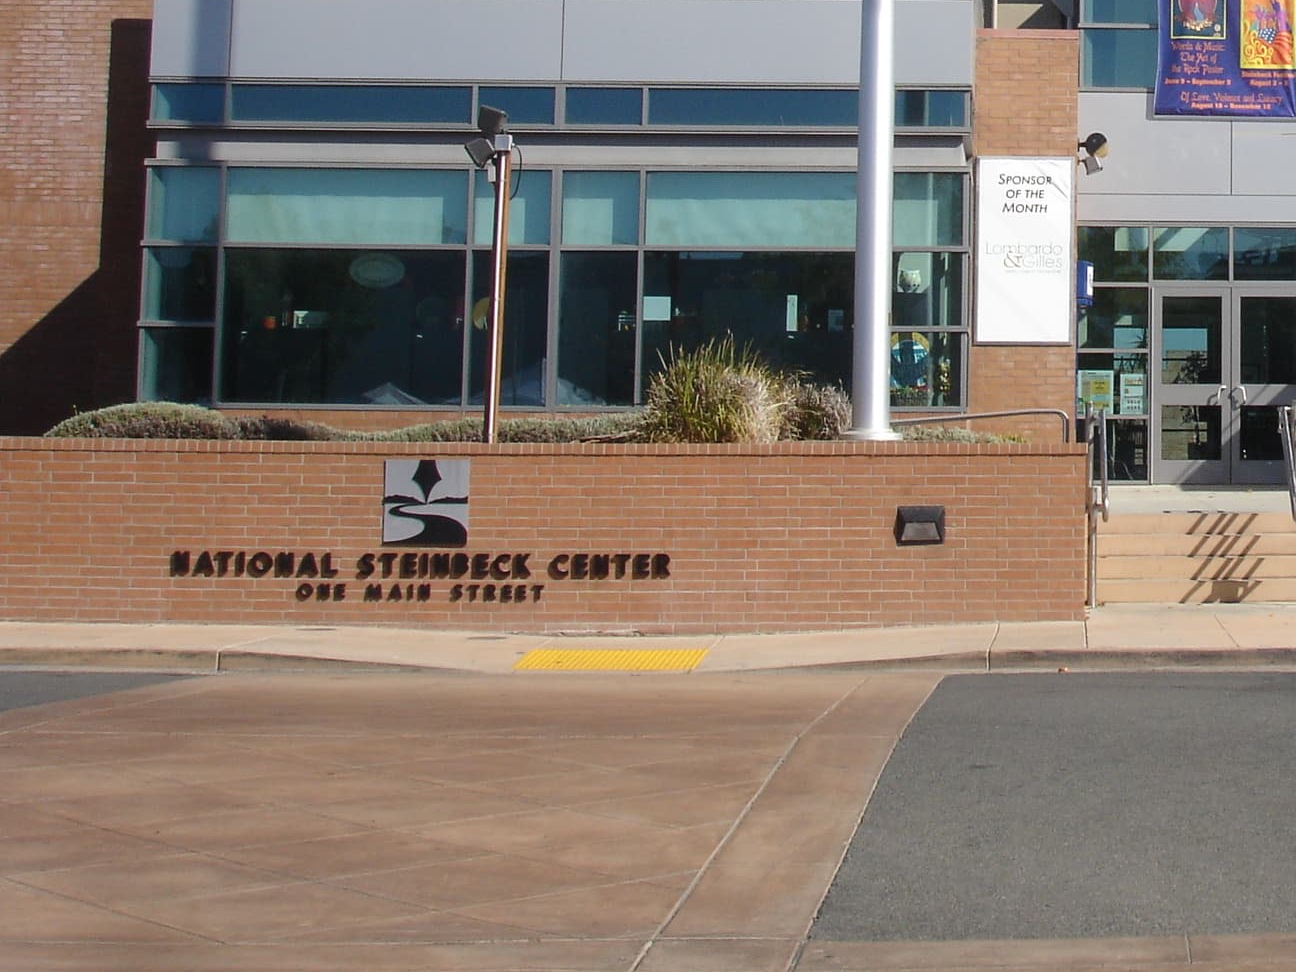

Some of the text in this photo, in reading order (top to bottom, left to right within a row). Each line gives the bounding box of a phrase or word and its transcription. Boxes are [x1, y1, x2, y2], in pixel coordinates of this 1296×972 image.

[1180, 51, 1195, 62] The
[1195, 52, 1209, 66] Art
[1183, 63, 1200, 75] Rock
[1191, 78, 1226, 86] September
[1249, 79, 1271, 87] August
[1190, 101, 1214, 110] August
[998, 173, 1053, 186] SPONSOR
[1005, 189, 1045, 199] OF THE
[1002, 202, 1048, 214] MONTH
[985, 241, 1064, 256] Lombardo
[1003, 249, 1063, 269] & Gilles
[169, 550, 672, 581] NATIONAL STEINBECK CENTER
[295, 583, 545, 604] ONE MAIN STREET
